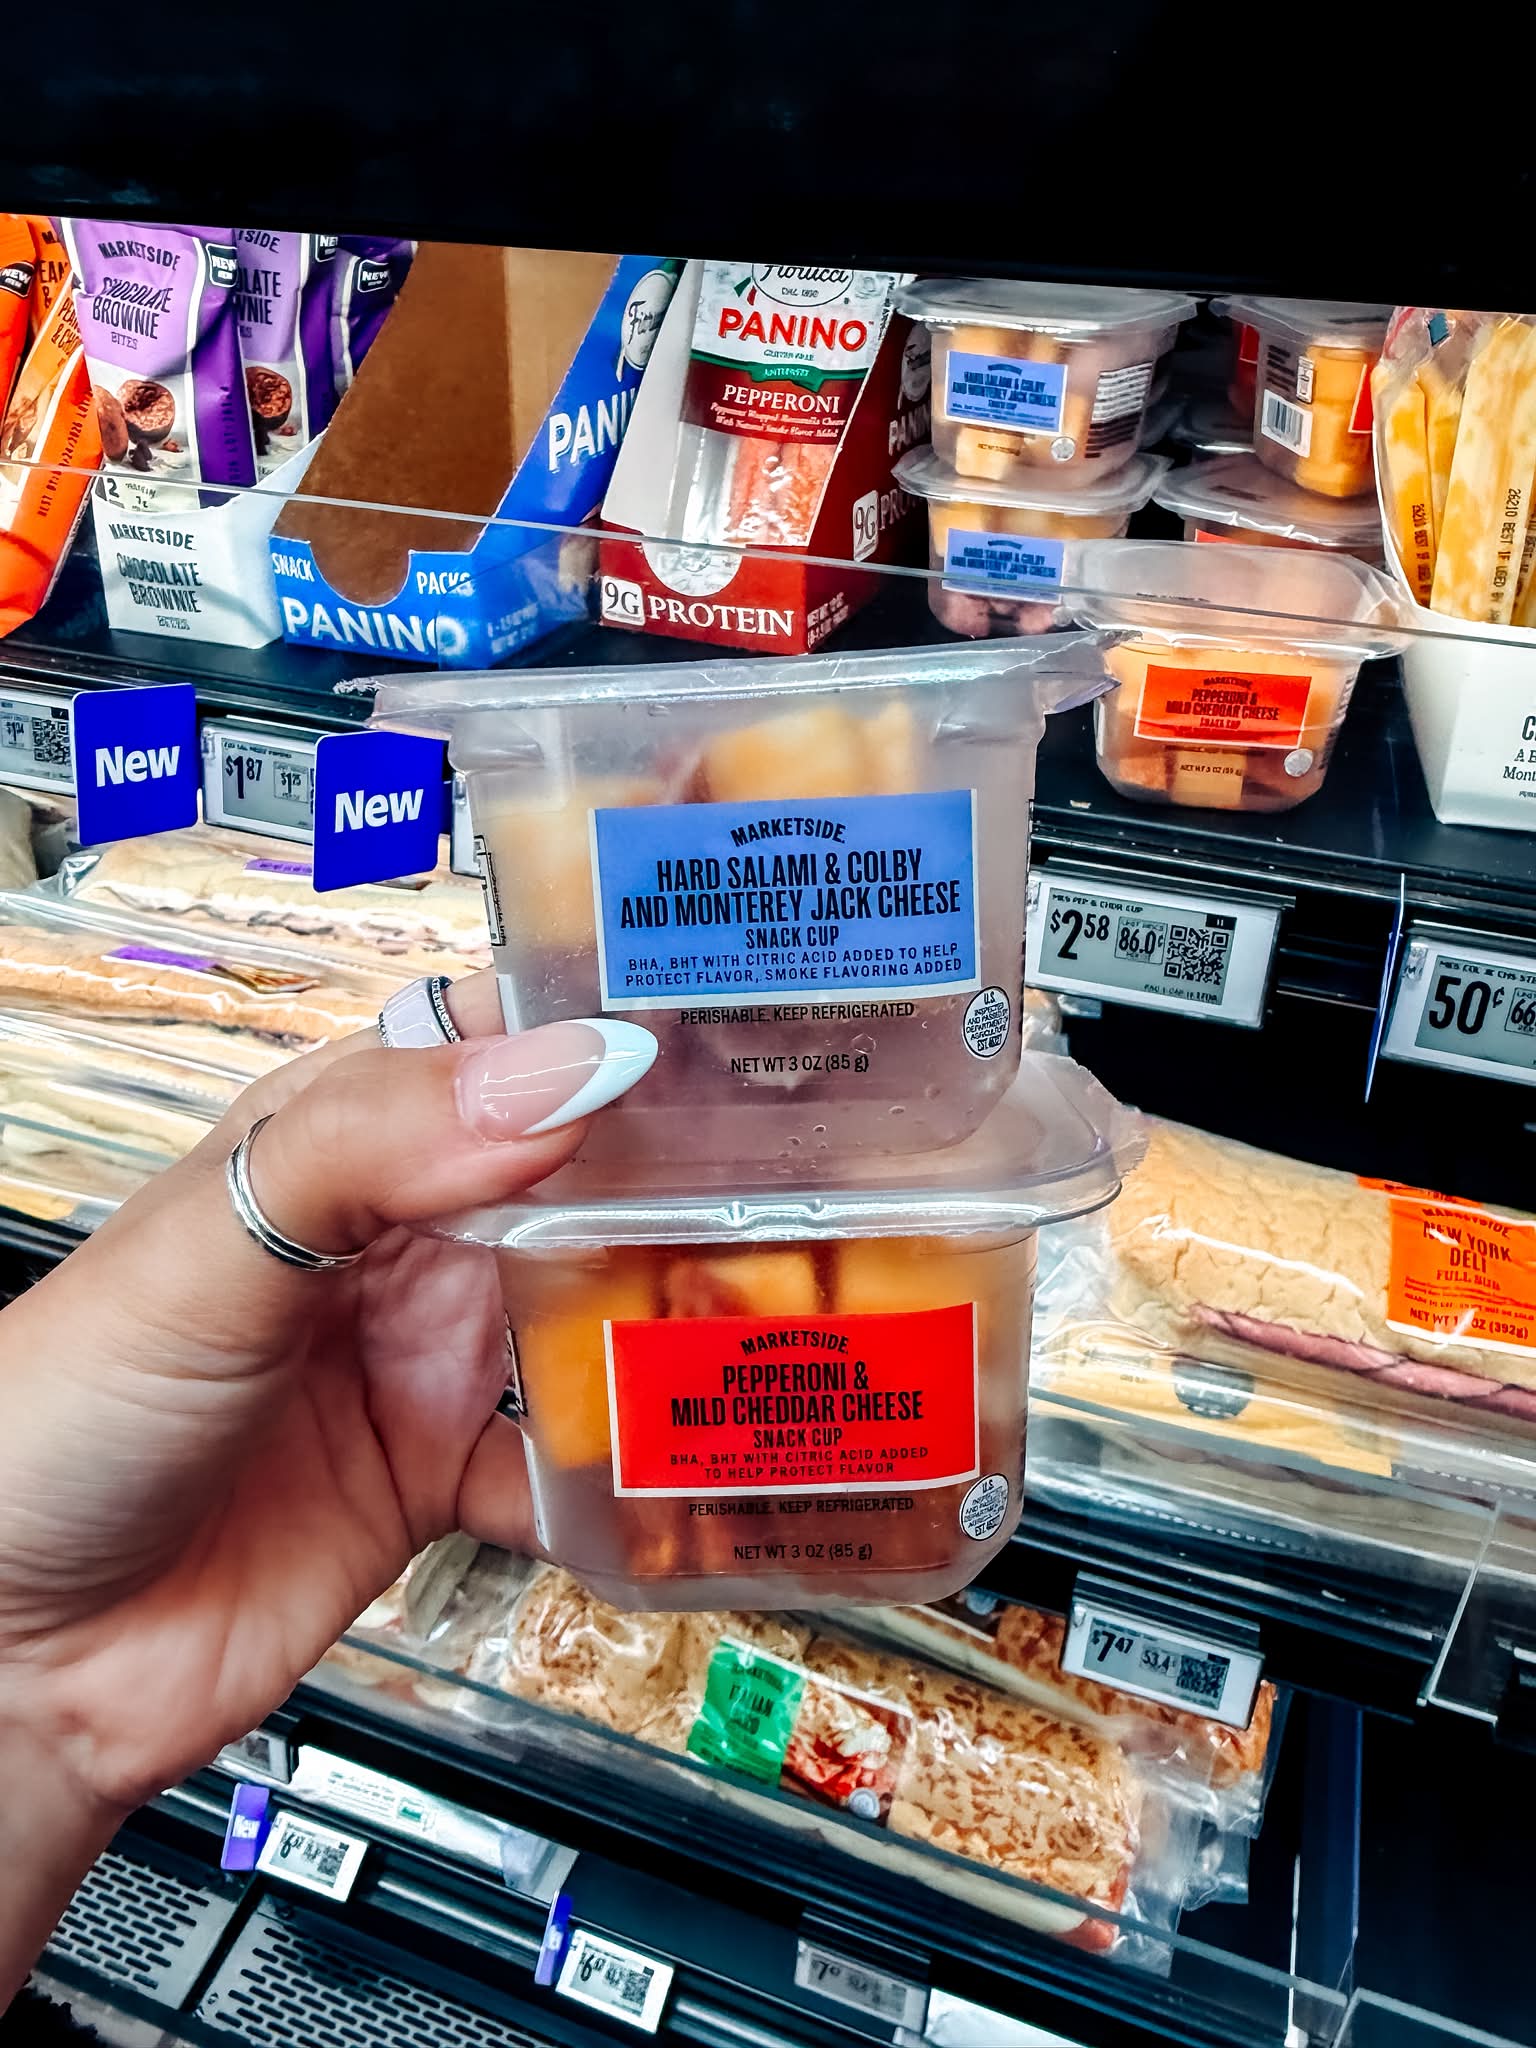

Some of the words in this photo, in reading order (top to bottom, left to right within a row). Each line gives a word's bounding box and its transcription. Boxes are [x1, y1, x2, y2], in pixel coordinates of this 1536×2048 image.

[98, 240, 180, 272] MARKETSIDE
[361, 270, 388, 282] NEW
[93, 295, 160, 340] BROWNIE
[718, 307, 868, 352] PANINO
[111, 331, 138, 350] BITES
[722, 384, 840, 414] PEPPERONI
[109, 523, 197, 550] MARKETSIDE
[854, 504, 877, 546] 9G
[271, 552, 315, 582] SNACK
[128, 581, 203, 613] BROWNIE
[604, 581, 640, 616] 9G
[647, 595, 795, 637] PROTEIN
[283, 596, 469, 656] PANINO
[1192, 703, 1241, 718] CHEDDAR
[1241, 705, 1280, 721] CHEESE
[1521, 715, 1536, 742] C
[94, 745, 181, 788] New
[1513, 748, 1525, 763] A
[334, 788, 424, 833] New
[730, 817, 847, 848] MARKETSIDE
[657, 857, 721, 893] HARD
[727, 853, 818, 890] SALAMI
[824, 852, 842, 885] &
[848, 848, 922, 884] COLBY
[621, 896, 669, 929] AND
[675, 889, 803, 927] MONTEREY
[811, 886, 872, 921] JACK
[878, 880, 961, 918] CHEESE
[746, 926, 802, 950] SNACK
[807, 925, 839, 947] CUP
[629, 959, 664, 972] BHA,
[670, 956, 697, 969] BHT
[703, 954, 740, 968] WITH
[746, 952, 797, 966] CITRIC
[801, 950, 837, 964] ACID
[843, 948, 894, 962] ADDED
[899, 947, 917, 959] TO
[923, 943, 958, 958] HELP
[626, 972, 690, 987] PROTECT
[696, 970, 760, 984] FLAVOR,
[765, 966, 818, 981] SMOKE
[823, 963, 909, 979] FLAVORING
[914, 958, 962, 975] ADDED
[774, 1006, 808, 1022] KEEP
[812, 1002, 914, 1020] REFRIGERATED
[731, 1057, 760, 1073] NET
[763, 1056, 786, 1073] WT
[788, 1056, 798, 1072] 3
[802, 1055, 822, 1071] OZ
[825, 1054, 850, 1074] (85
[854, 1054, 870, 1073] g)
[1450, 1247, 1487, 1273] DELI
[1467, 1233, 1513, 1262] YORK
[1436, 1270, 1472, 1283] FULL
[1410, 1307, 1430, 1323] NET
[740, 1330, 849, 1356] MARKETSIDE
[722, 1362, 847, 1394] PEPPERONI
[853, 1360, 869, 1390] &
[671, 1396, 726, 1427] MILD
[732, 1393, 835, 1426] CHEDDAR
[842, 1390, 924, 1422] CHEESE
[753, 1428, 806, 1449] SNACK
[812, 1427, 842, 1447] CUP
[670, 1454, 704, 1466] BHA,
[711, 1453, 737, 1465] BHT
[744, 1452, 779, 1464] WITH
[785, 1450, 833, 1463] CITRIC
[839, 1449, 873, 1461] ACID
[880, 1446, 929, 1459] ADDED
[704, 1467, 721, 1479] TO
[728, 1466, 764, 1479] HELP
[770, 1464, 833, 1477] PROTECT
[840, 1462, 894, 1475] FLAVOR
[779, 1500, 812, 1514] KEEP
[816, 1497, 914, 1513] REFRIGERATED
[734, 1545, 760, 1560] NET
[765, 1544, 788, 1560] WT
[791, 1544, 800, 1559] 3
[805, 1544, 824, 1558] OZ
[829, 1544, 853, 1561] (85
[859, 1543, 873, 1561] g)
